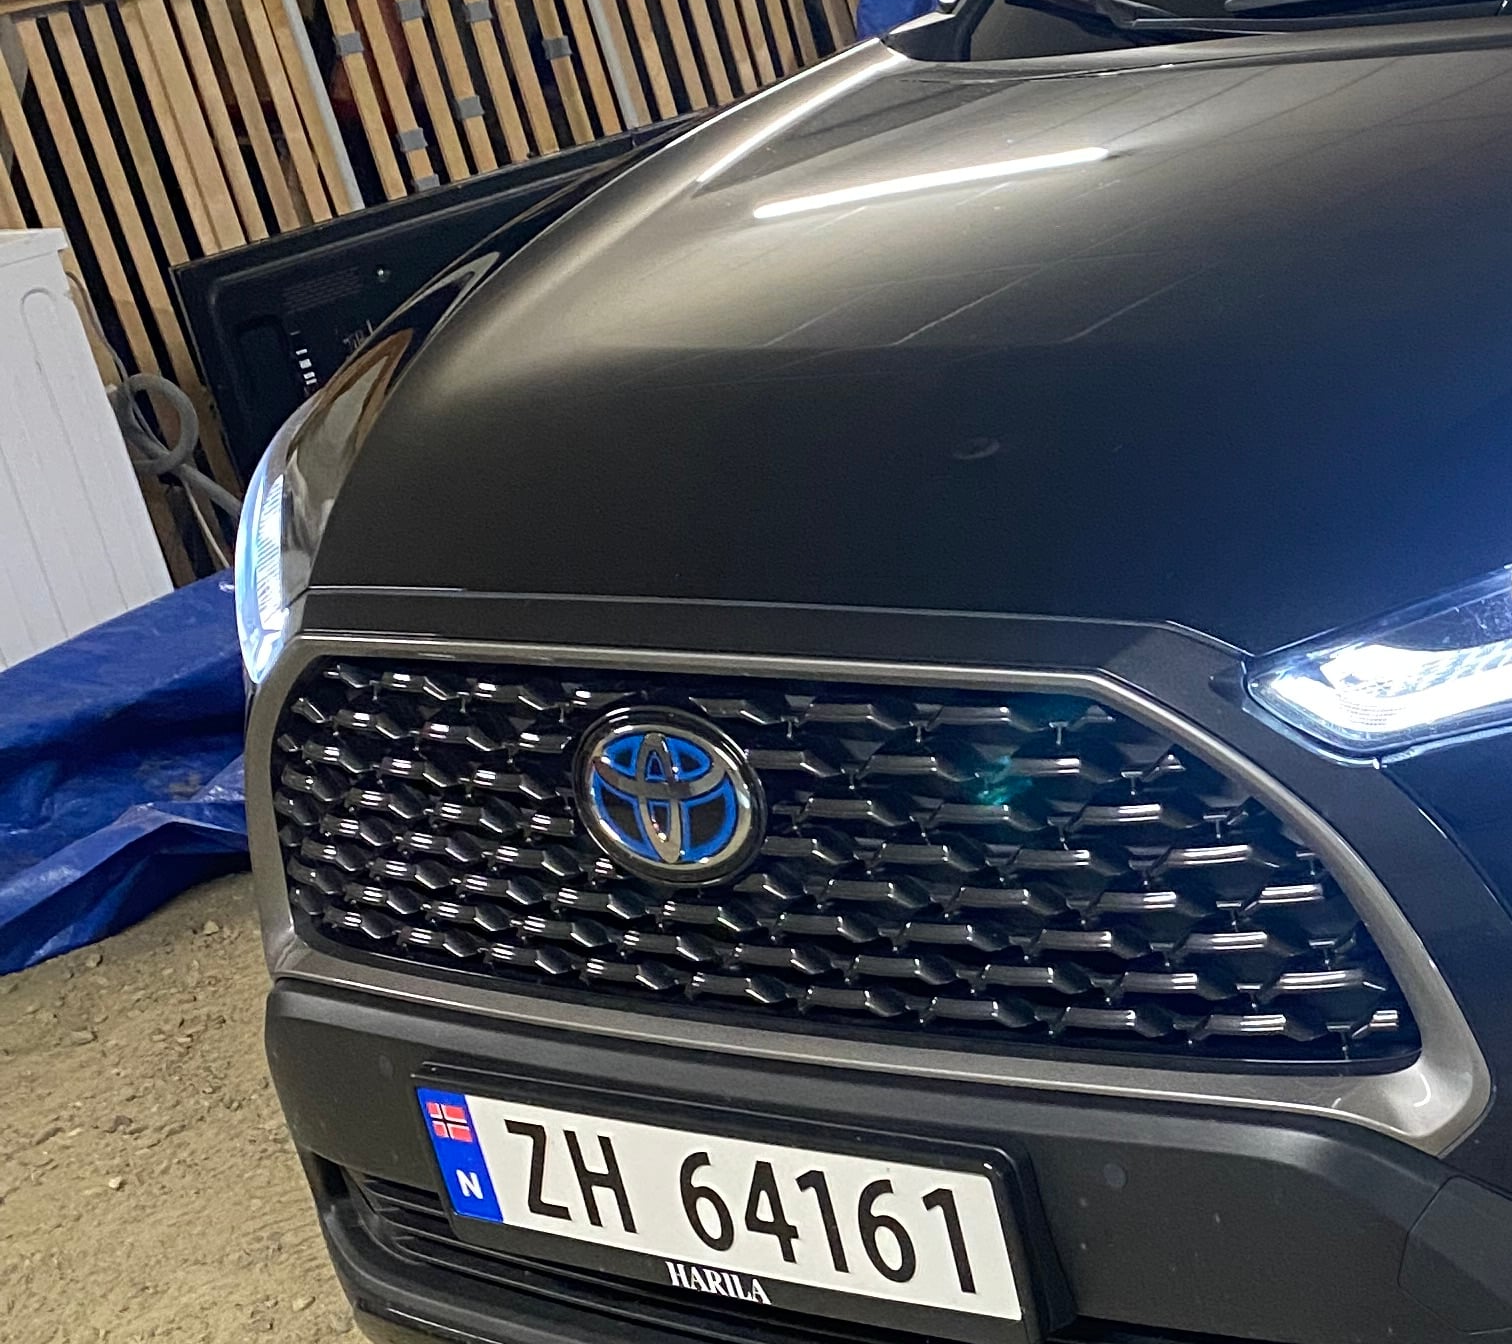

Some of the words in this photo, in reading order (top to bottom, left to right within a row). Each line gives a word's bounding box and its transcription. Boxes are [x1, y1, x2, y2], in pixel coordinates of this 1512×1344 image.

[456, 1169, 484, 1200] N
[504, 1119, 638, 1234] ZH
[680, 1151, 976, 1294] 64161
[665, 1261, 772, 1305] HARILA
